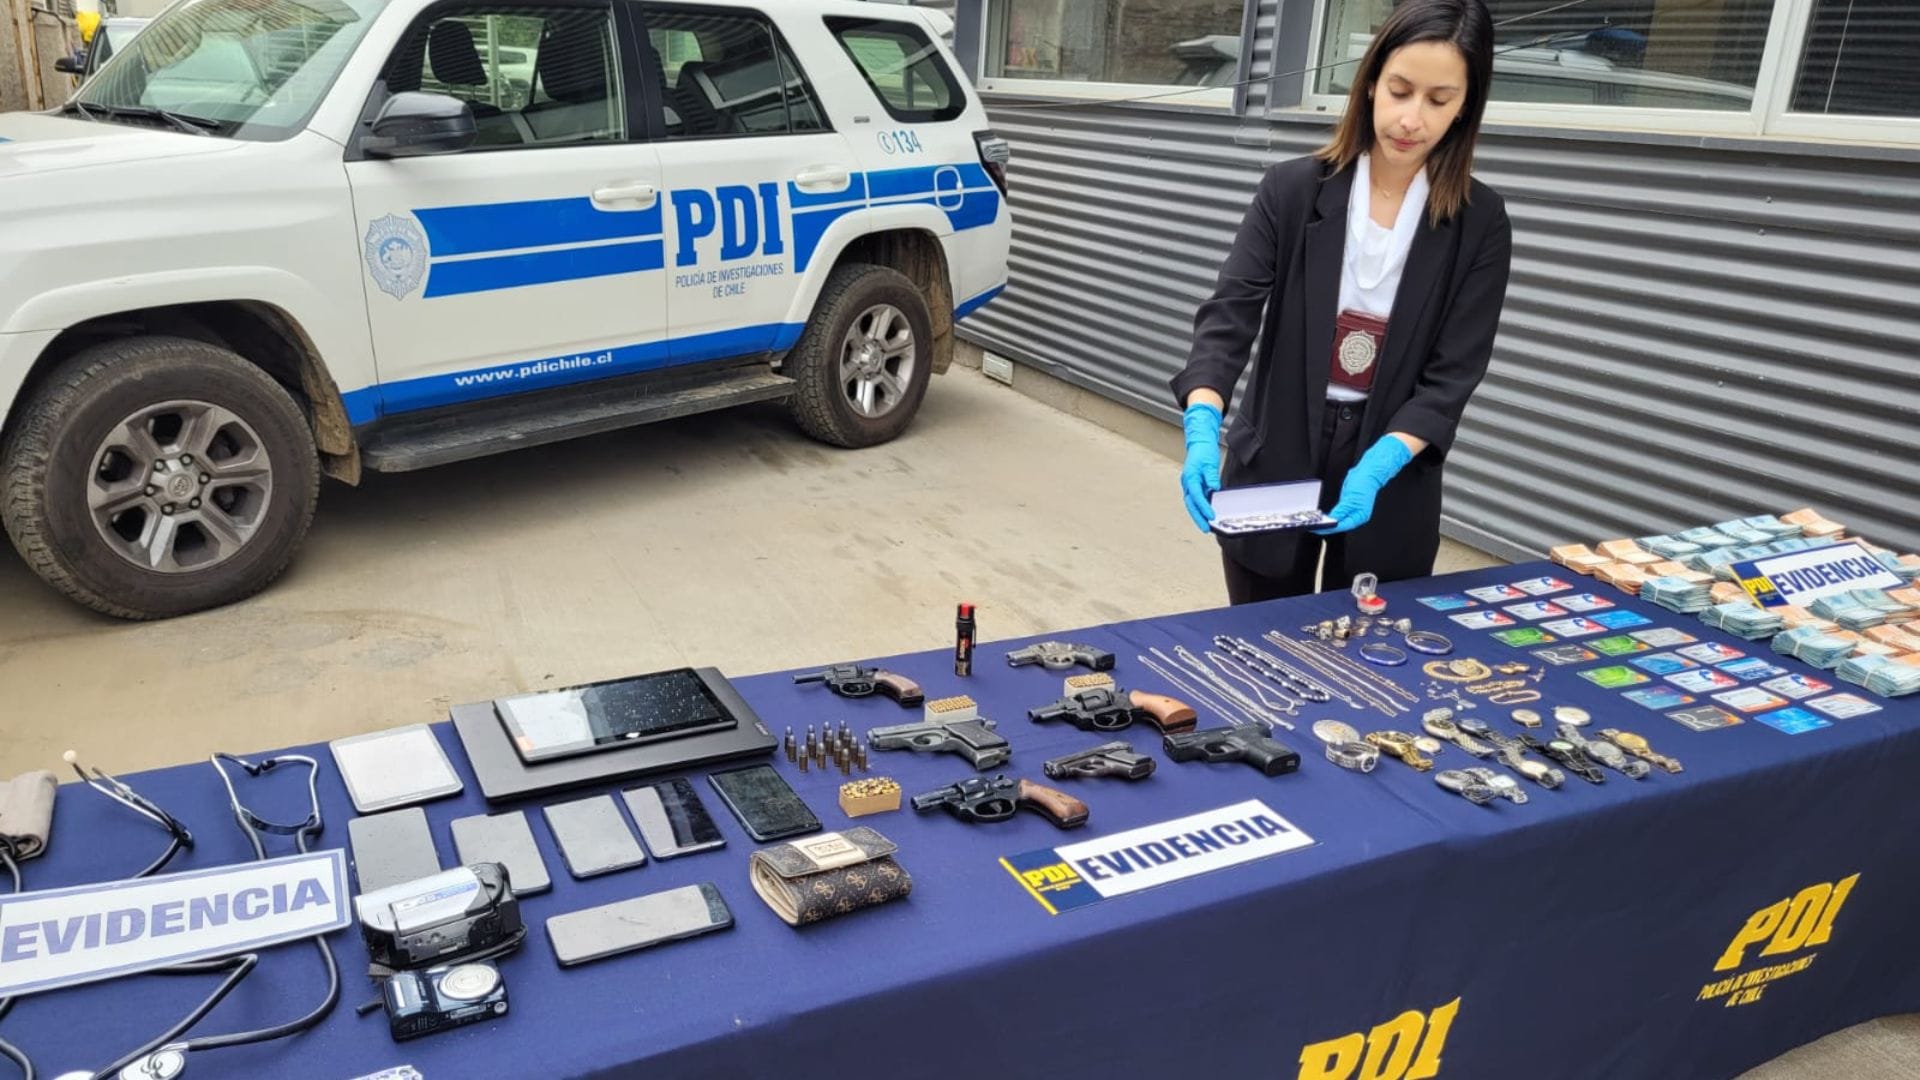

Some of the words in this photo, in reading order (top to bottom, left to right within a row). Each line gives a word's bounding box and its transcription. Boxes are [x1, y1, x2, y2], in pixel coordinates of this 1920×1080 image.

[892, 130, 923, 153] 134
[671, 182, 784, 267] PDI
[707, 271, 717, 283] DE
[719, 262, 784, 282] INVESTIGACIONES
[713, 286, 723, 298] DE
[724, 282, 746, 297] CHILE
[454, 351, 613, 386] www.pdichile.cl
[1768, 556, 1887, 596] EVIDENCIA
[1021, 863, 1078, 888] PDI
[1076, 814, 1291, 881] EVIDENCIA
[0, 878, 331, 963] EVIDENCIA
[1713, 872, 1862, 971] PDI
[1297, 996, 1462, 1080] PDI
